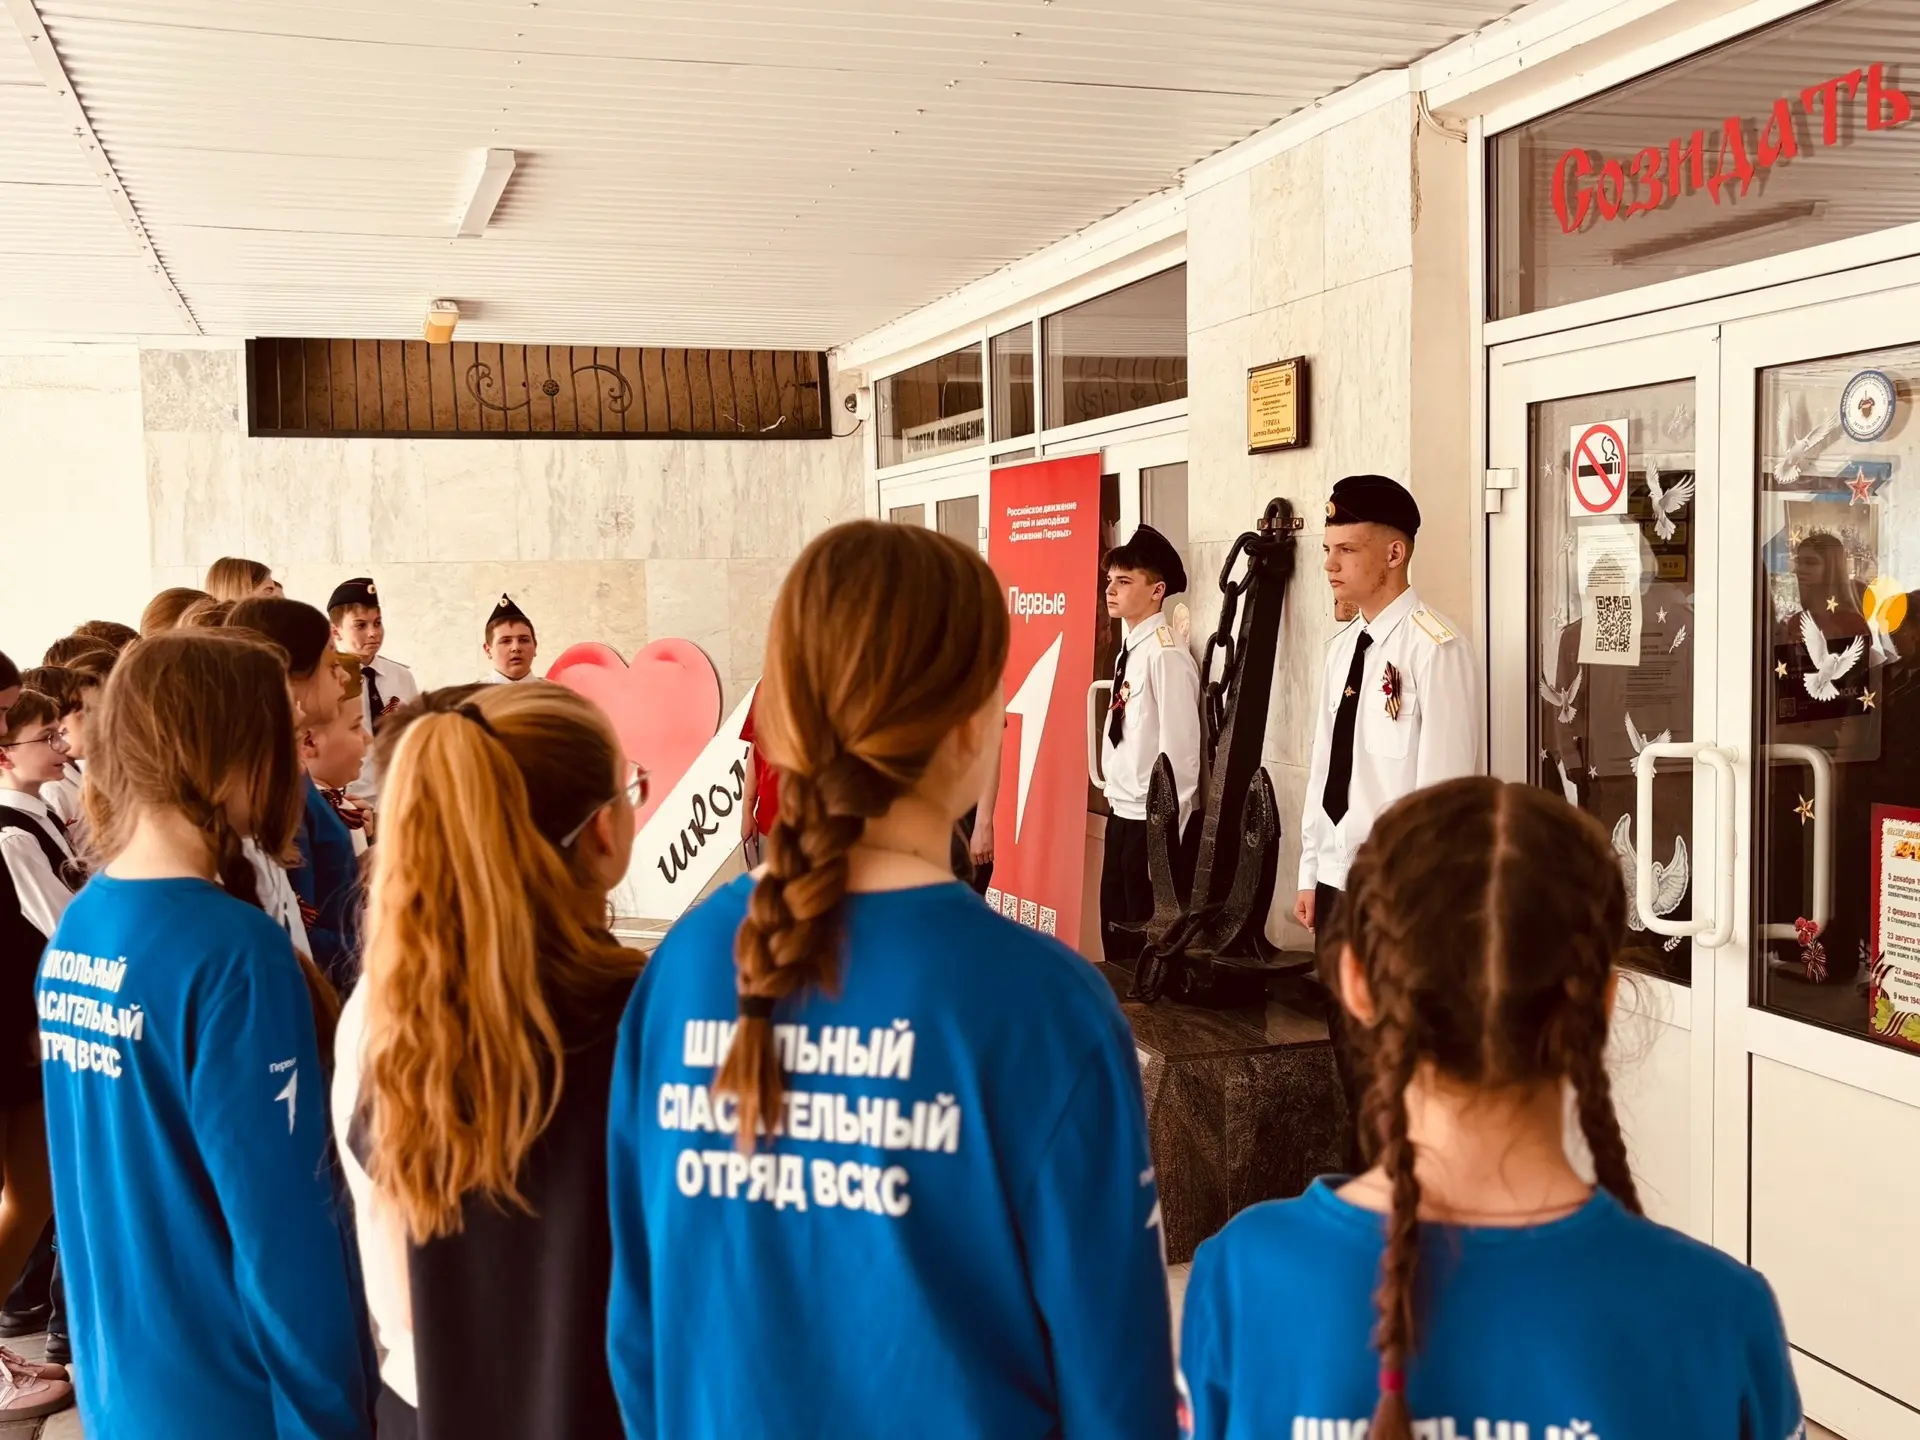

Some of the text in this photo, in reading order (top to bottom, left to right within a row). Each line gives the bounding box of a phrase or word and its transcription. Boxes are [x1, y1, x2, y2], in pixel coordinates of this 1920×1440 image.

[1007, 501, 1077, 517] Российское движение
[1012, 514, 1070, 530] детей и молодёжи
[1008, 586, 1066, 624] Первые
[657, 746, 750, 884] школ
[1893, 875, 1915, 885] декабря
[1892, 908, 1917, 918] февраля
[1887, 932, 1894, 940] 23
[1895, 934, 1915, 944] августа
[1895, 966, 1901, 974] 27
[1893, 991, 1897, 999] 9
[1898, 994, 1909, 1002] мая
[683, 1018, 916, 1080] ШКЛЬНЫЙ
[657, 1082, 961, 1153] СПАСЕЛЬНЫЙ
[676, 1148, 911, 1217] ОТРЯД ВСКС
